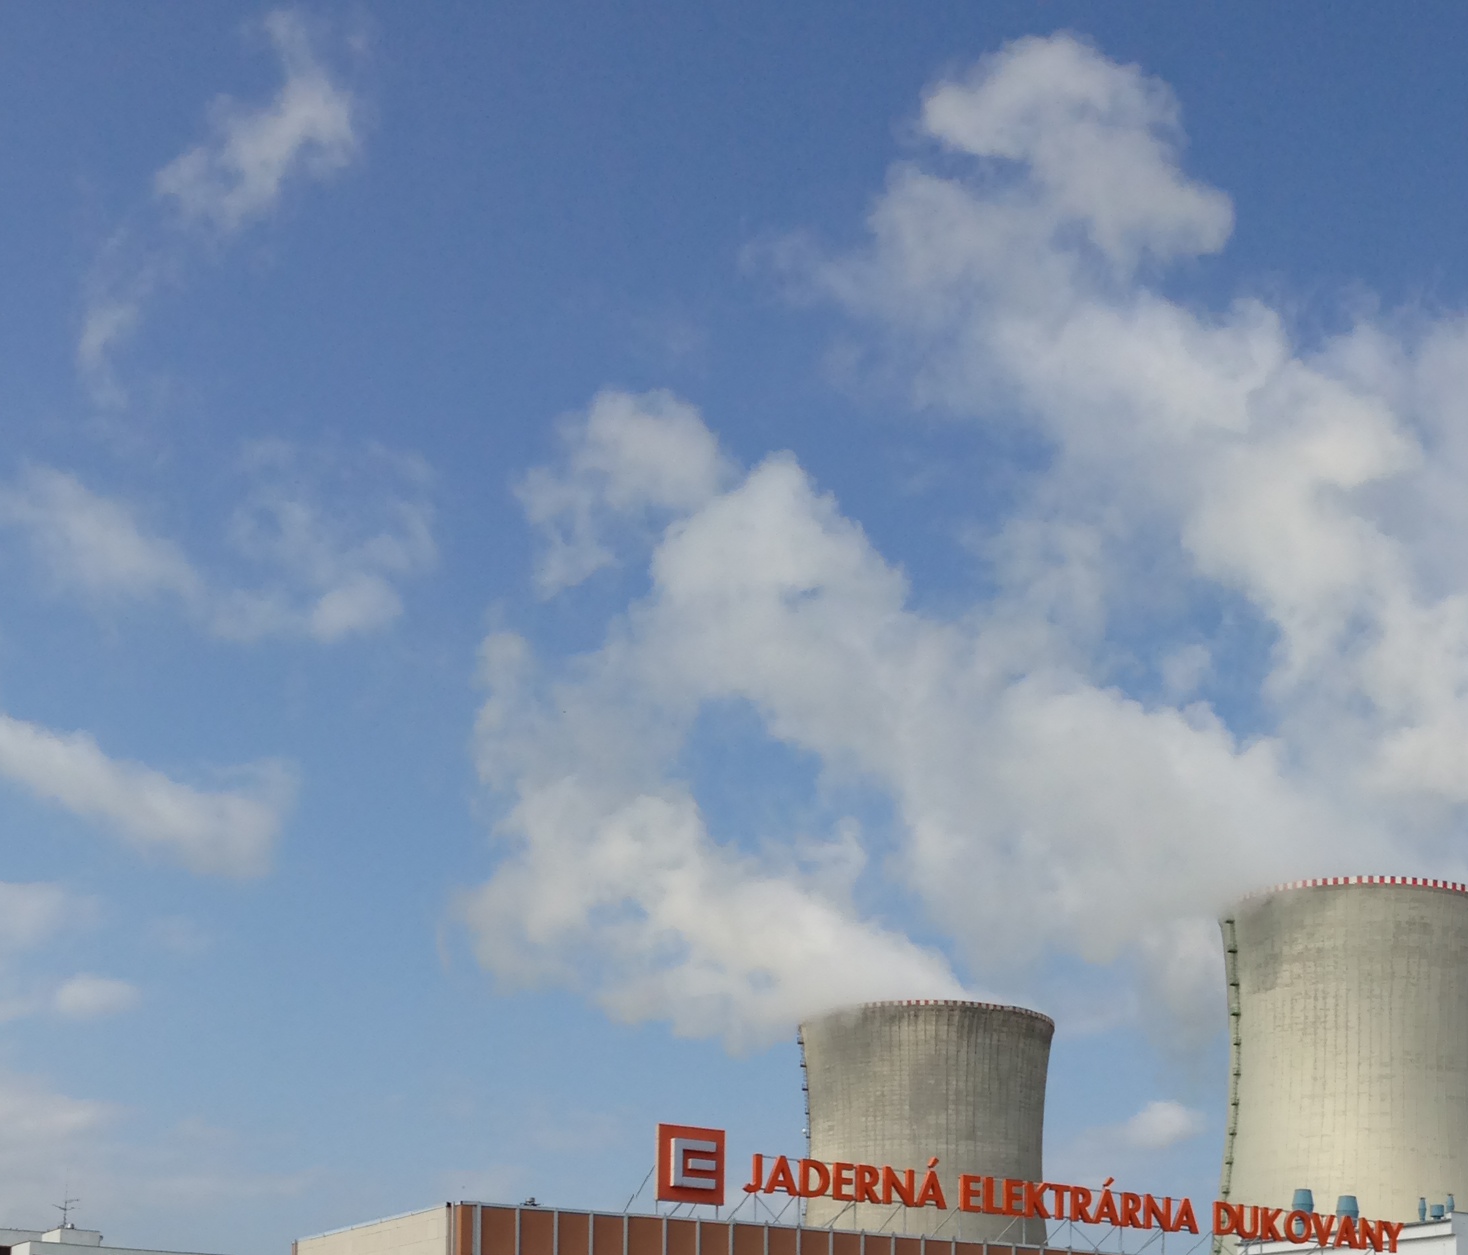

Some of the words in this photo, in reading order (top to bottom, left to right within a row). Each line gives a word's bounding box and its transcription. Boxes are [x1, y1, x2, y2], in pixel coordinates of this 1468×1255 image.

[743, 1153, 947, 1210] JADERNÁ
[958, 1174, 1199, 1234] ELEKTRÁRNA
[1213, 1201, 1404, 1253] DUKOVANY
